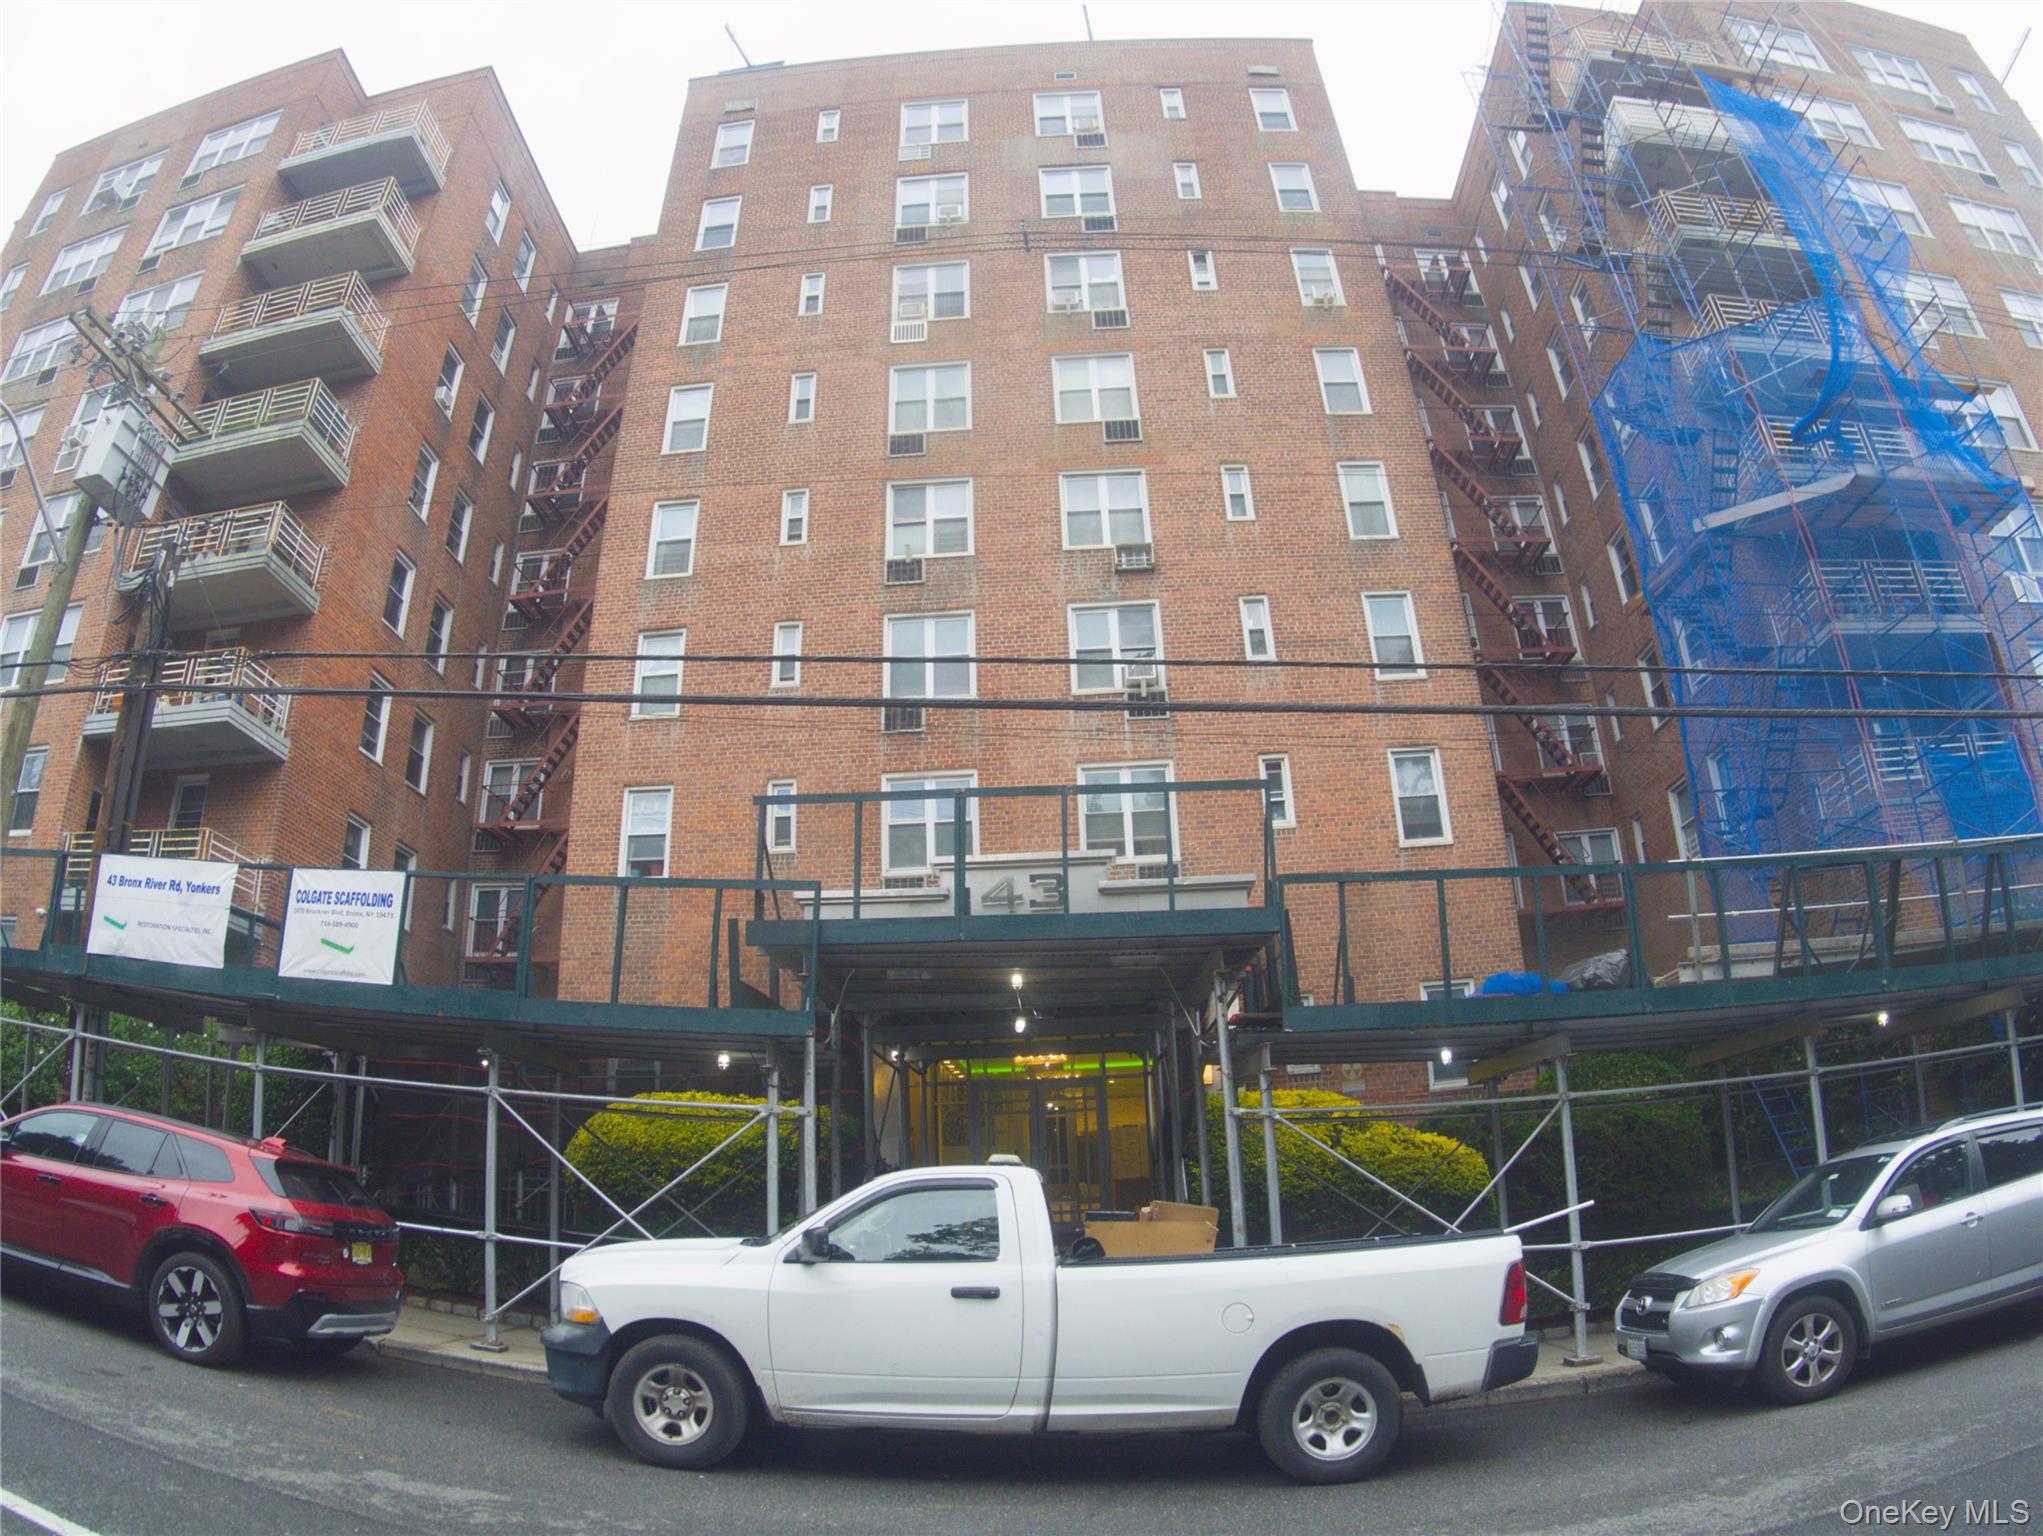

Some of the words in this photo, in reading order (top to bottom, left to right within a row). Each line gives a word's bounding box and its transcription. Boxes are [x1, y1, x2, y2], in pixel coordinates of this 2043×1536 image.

[107, 874, 117, 887] 43
[118, 875, 142, 889] Bronx
[144, 877, 167, 890] River
[168, 880, 183, 894] Rd,
[186, 880, 222, 895] Yonkers
[981, 874, 1064, 912] 43
[296, 889, 333, 905] COLGATE
[334, 891, 394, 908] SCAFFOLDING
